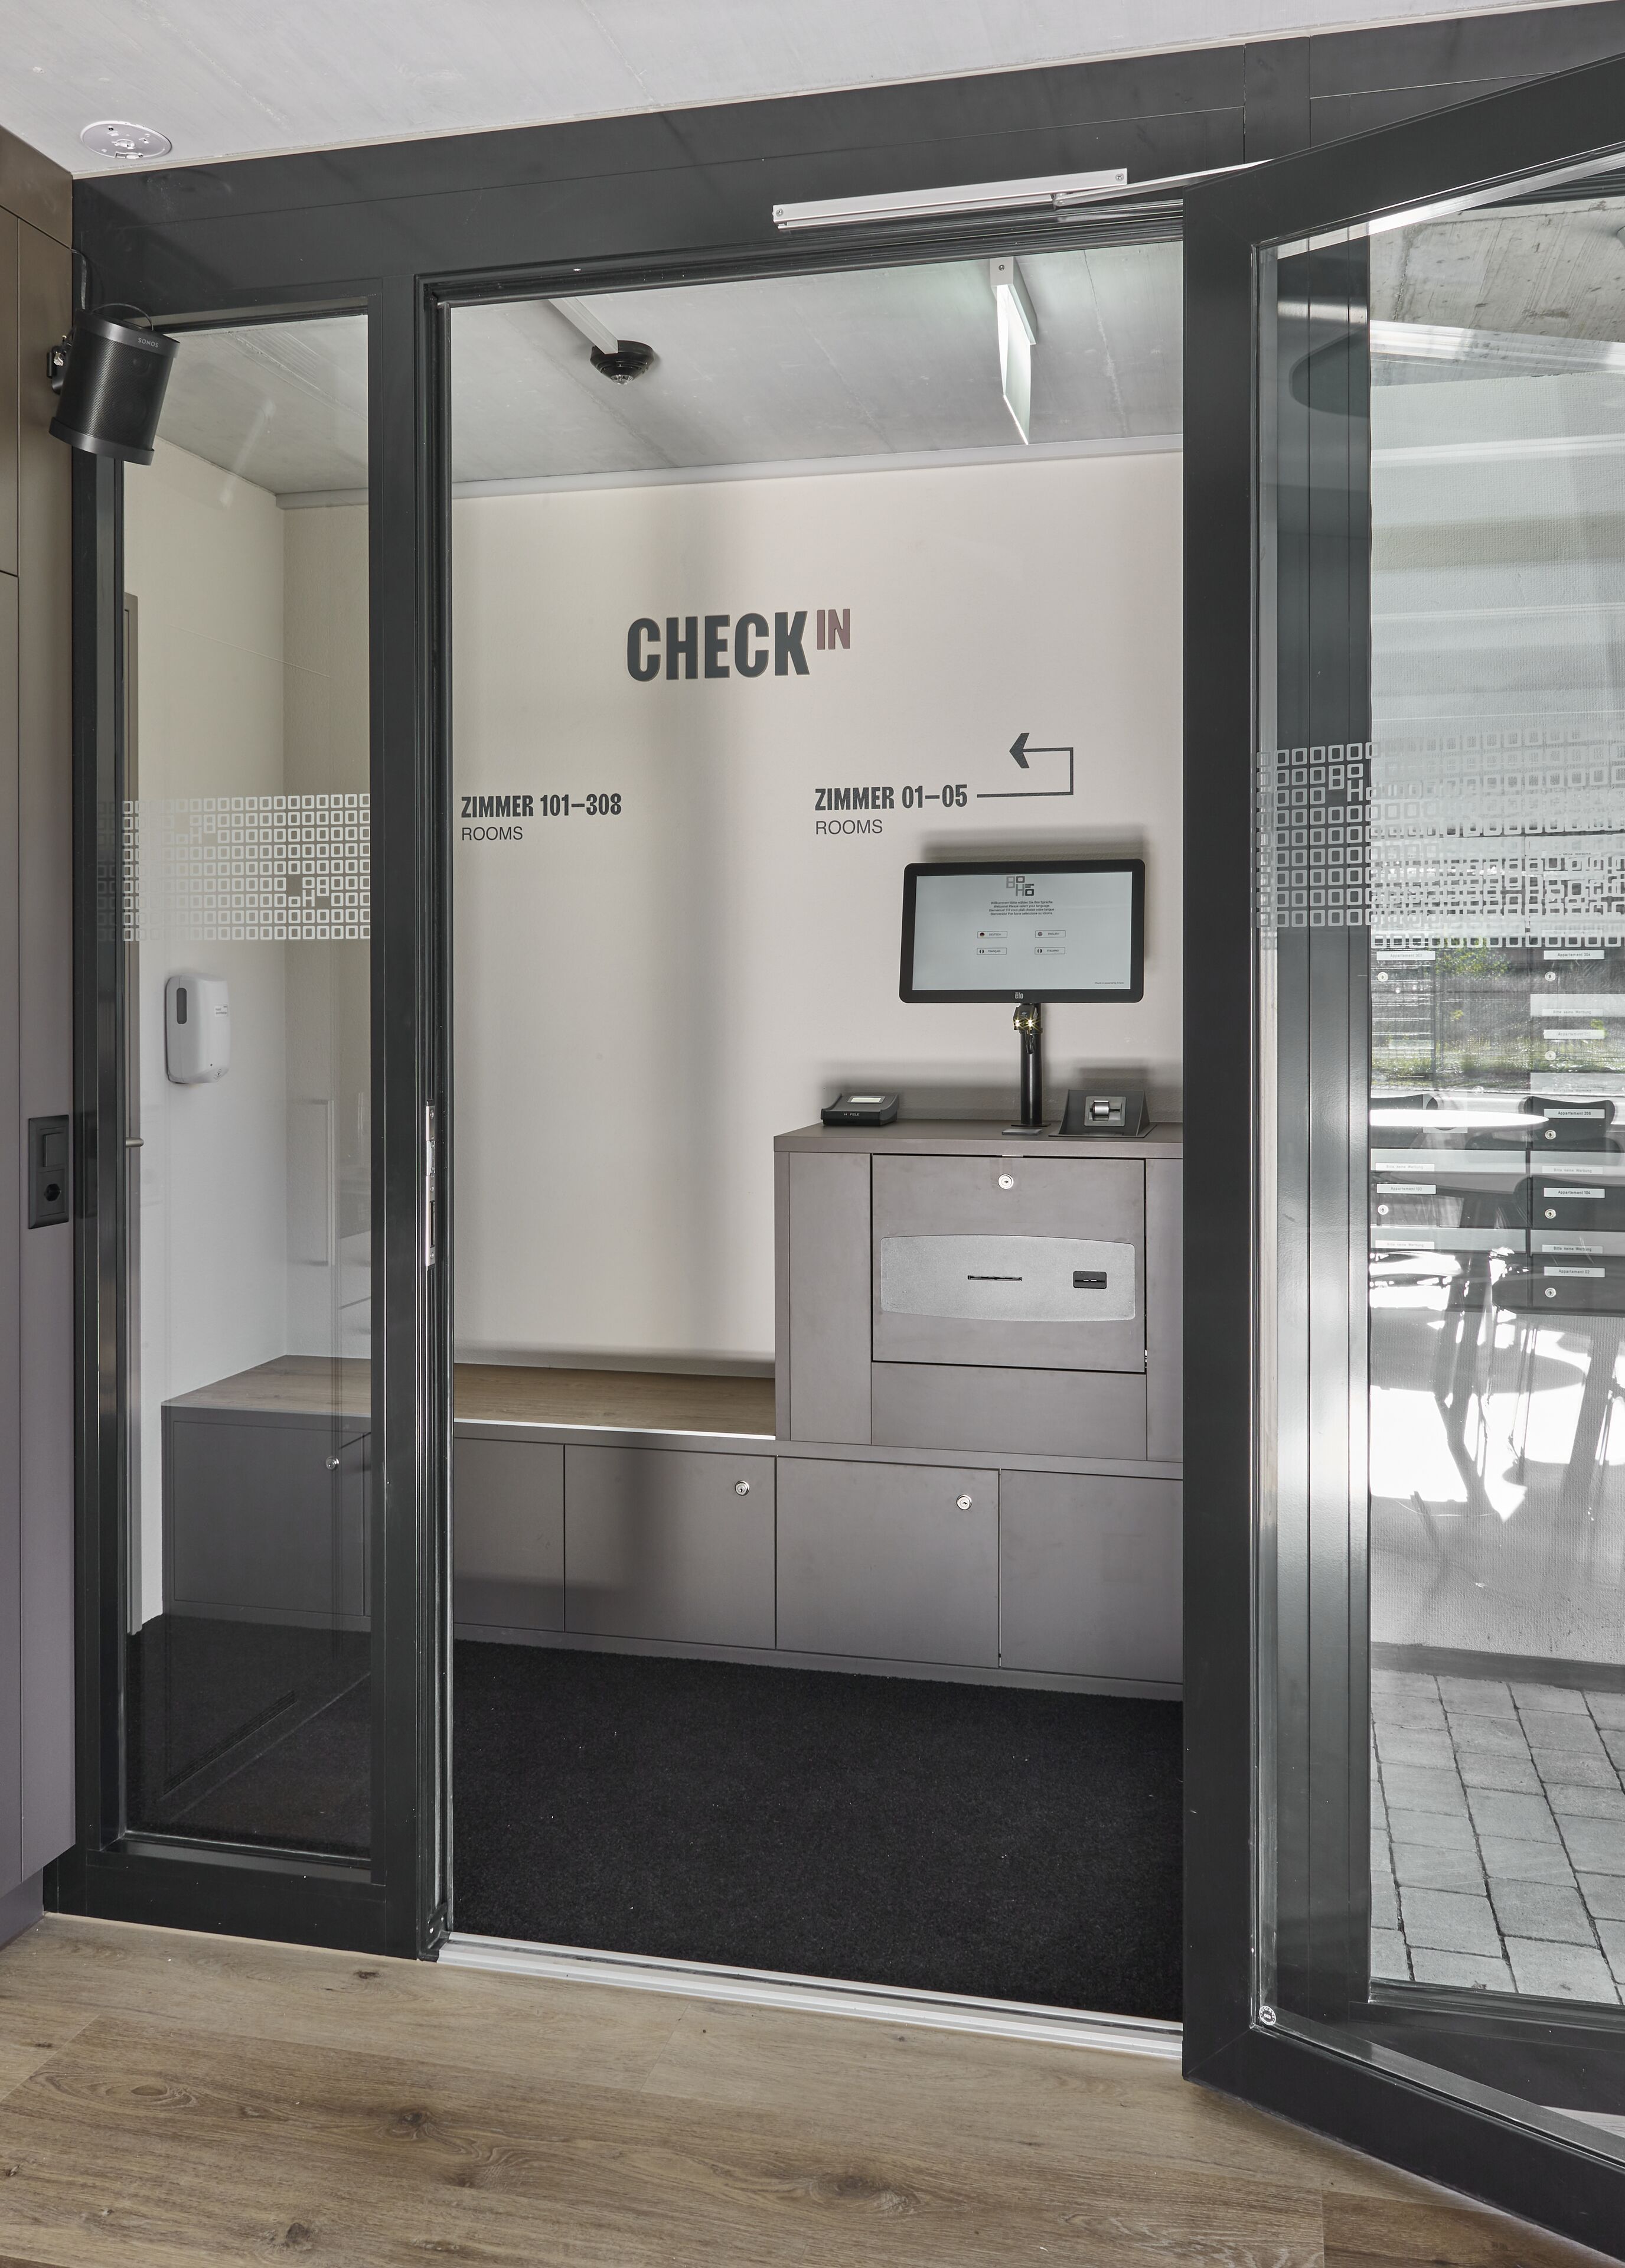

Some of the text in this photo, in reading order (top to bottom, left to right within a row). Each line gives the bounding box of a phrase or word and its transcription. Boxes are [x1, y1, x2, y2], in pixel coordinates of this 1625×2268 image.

[138, 337, 159, 348] SONOS
[627, 608, 850, 682] CHECK IN
[461, 795, 534, 818] ZIMMER
[815, 786, 895, 811] ZIMMER
[462, 826, 523, 841] ROOMS
[816, 819, 883, 835] ROOMS
